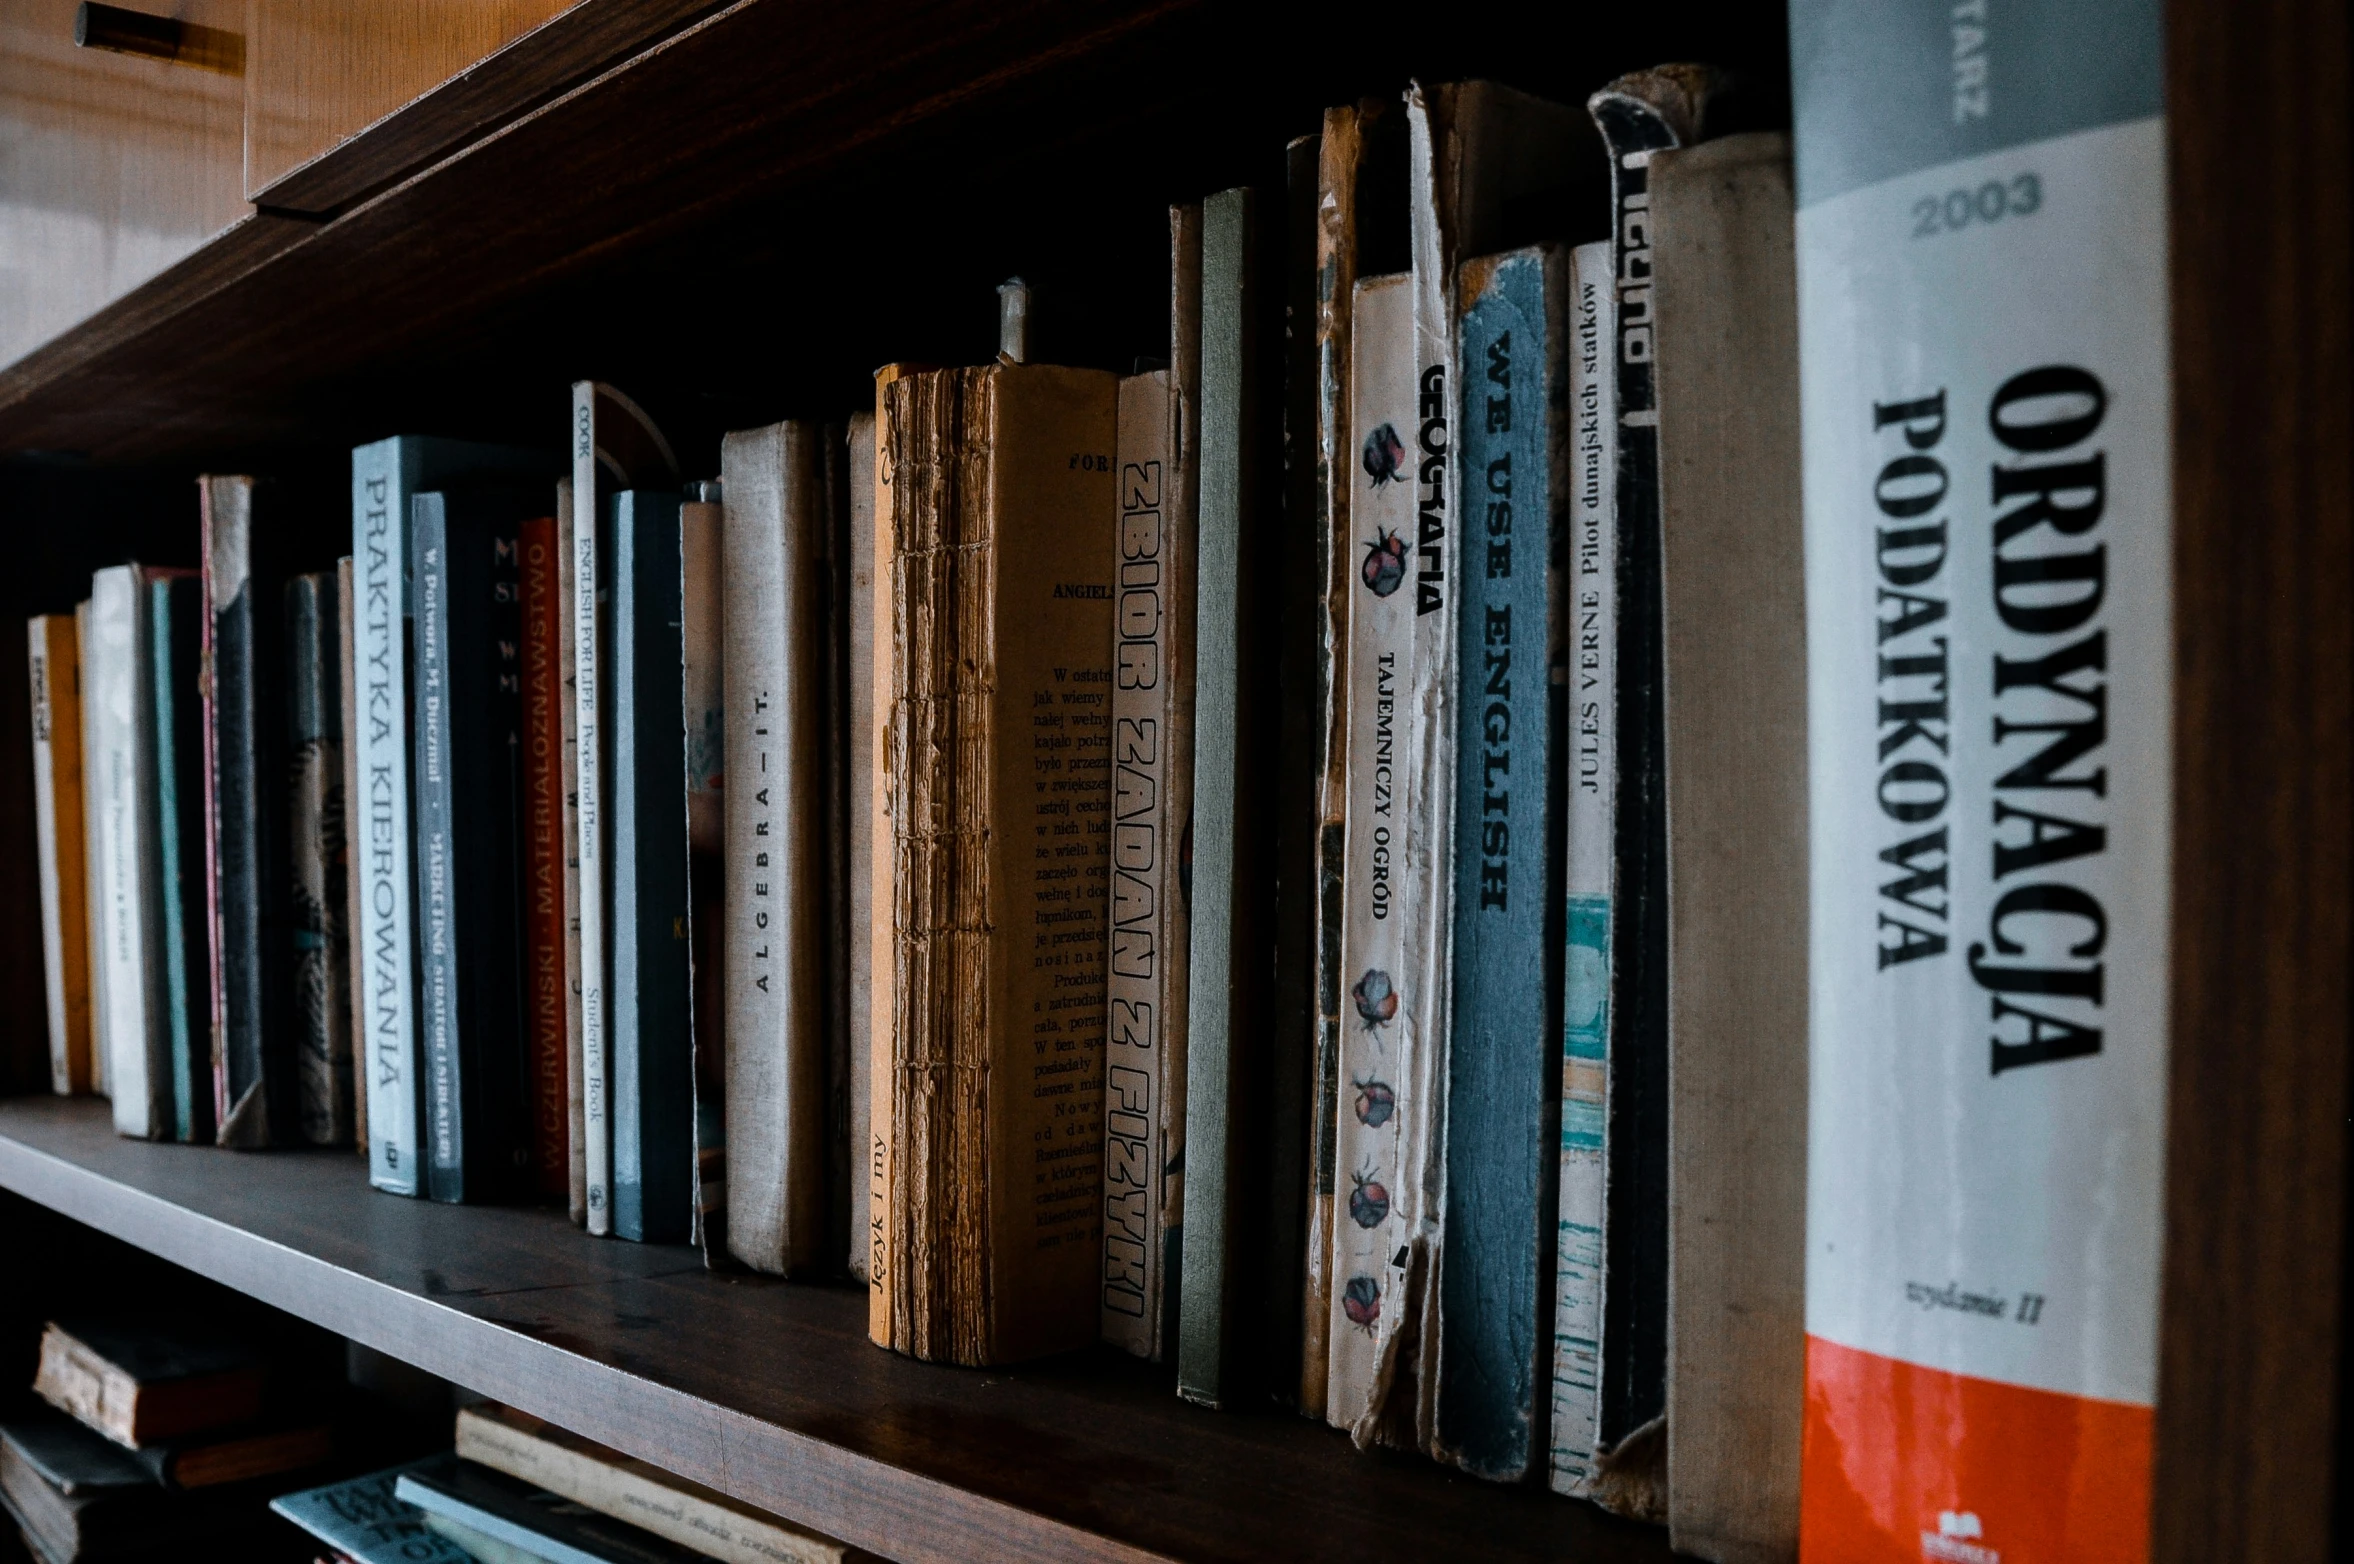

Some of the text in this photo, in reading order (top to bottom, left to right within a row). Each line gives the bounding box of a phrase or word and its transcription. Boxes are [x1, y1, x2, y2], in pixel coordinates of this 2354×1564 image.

[1911, 172, 2044, 240] 2003
[578, 405, 590, 458] COOK
[1579, 282, 1602, 795] JULES VERNE Pilot dunajskich statków
[1481, 329, 1512, 912] WE USE ENGLISH
[579, 538, 596, 859] ENGLISH FOR LIFE People and Places
[1033, 690, 1104, 707] jak wiemy
[1053, 668, 1067, 682] W
[1873, 388, 1951, 972] PODATKOWA
[1967, 365, 2108, 1077] ORDYNACJA
[366, 478, 400, 1088] PRAKTYKA KIEROWANIA
[1035, 757, 1061, 773] było
[1035, 783, 1046, 793] w
[1372, 652, 1394, 921] TAJEMNICZY OGRÓD
[1036, 826, 1047, 836] w
[1054, 821, 1079, 835] nich
[1056, 843, 1088, 857] wielu
[430, 832, 444, 956] MARKETING
[756, 787, 768, 992] ALGEBRA
[1104, 460, 1162, 1318] ZBIÓR ZADAŃ Z FIZYKI
[1035, 933, 1047, 948] je
[1034, 1001, 1041, 1012] a
[587, 987, 602, 1123] Student's Book
[1034, 1041, 1047, 1054] W
[1056, 1039, 1075, 1051] ten
[1034, 1058, 1091, 1079] posiadały
[1034, 1081, 1074, 1098] dawne
[1052, 1164, 1096, 1181] którym
[871, 1133, 887, 1295] Język i my
[1066, 1229, 1085, 1243] nie
